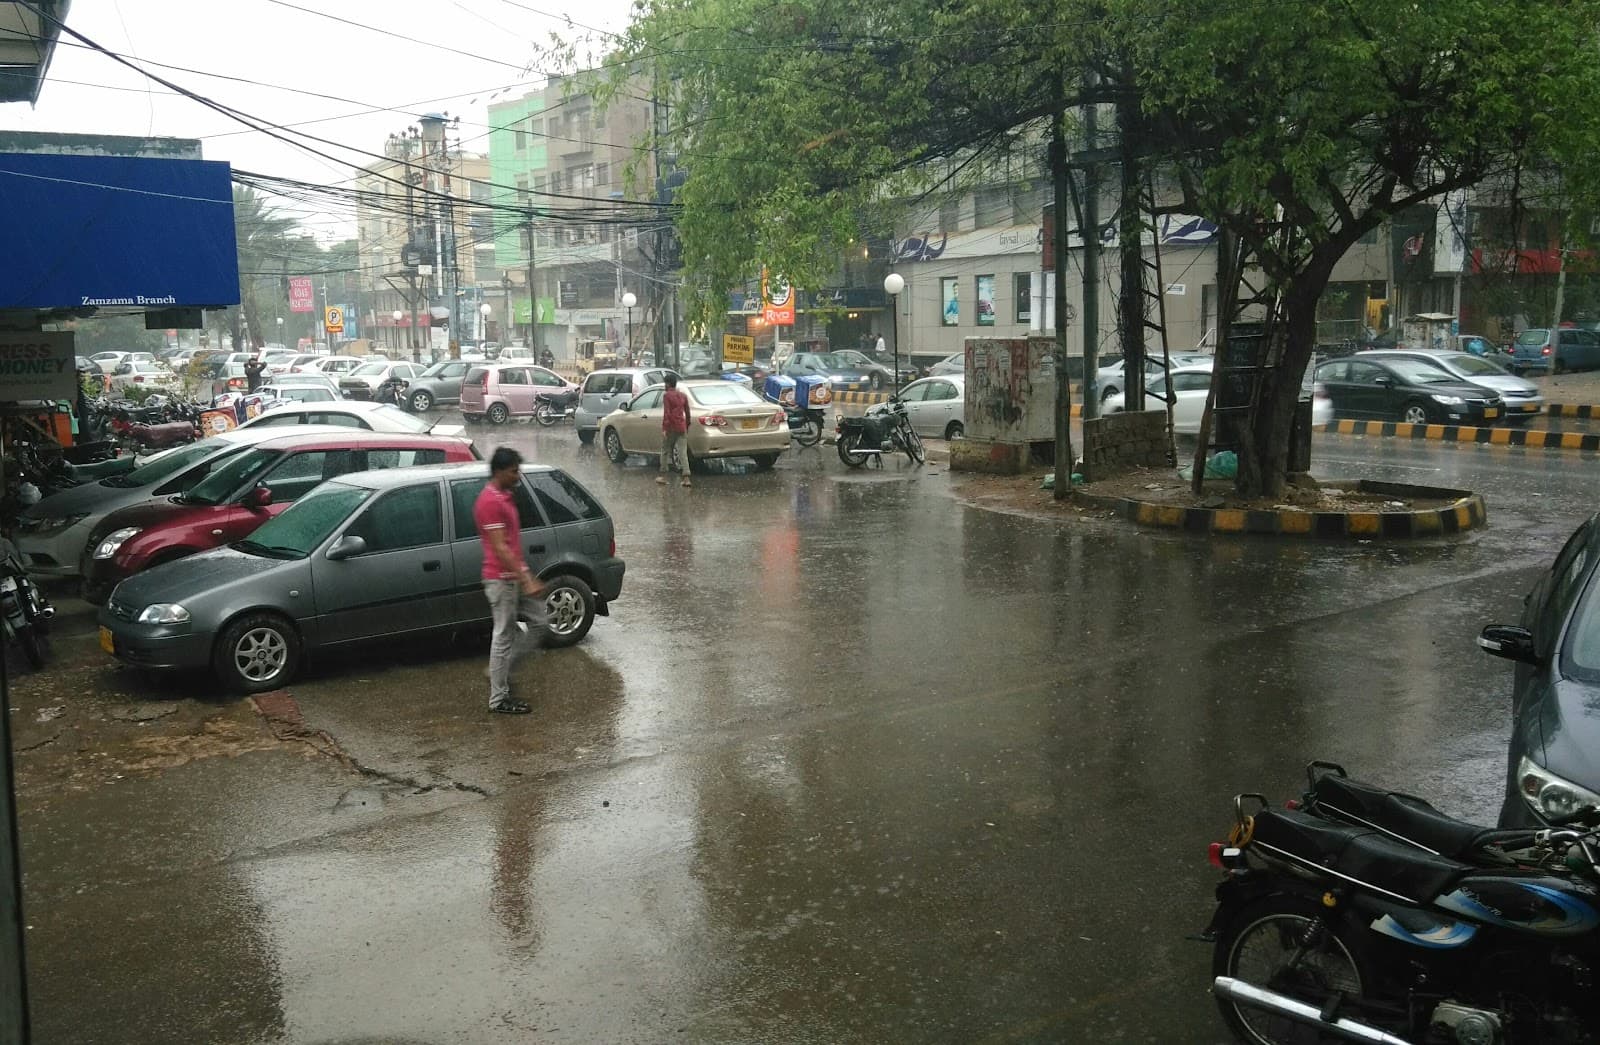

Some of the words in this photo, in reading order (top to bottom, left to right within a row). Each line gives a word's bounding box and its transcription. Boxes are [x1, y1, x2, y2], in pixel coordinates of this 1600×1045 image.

[81, 296, 134, 305] Zamzama
[136, 295, 176, 304] Branch
[727, 343, 750, 352] PARKING
